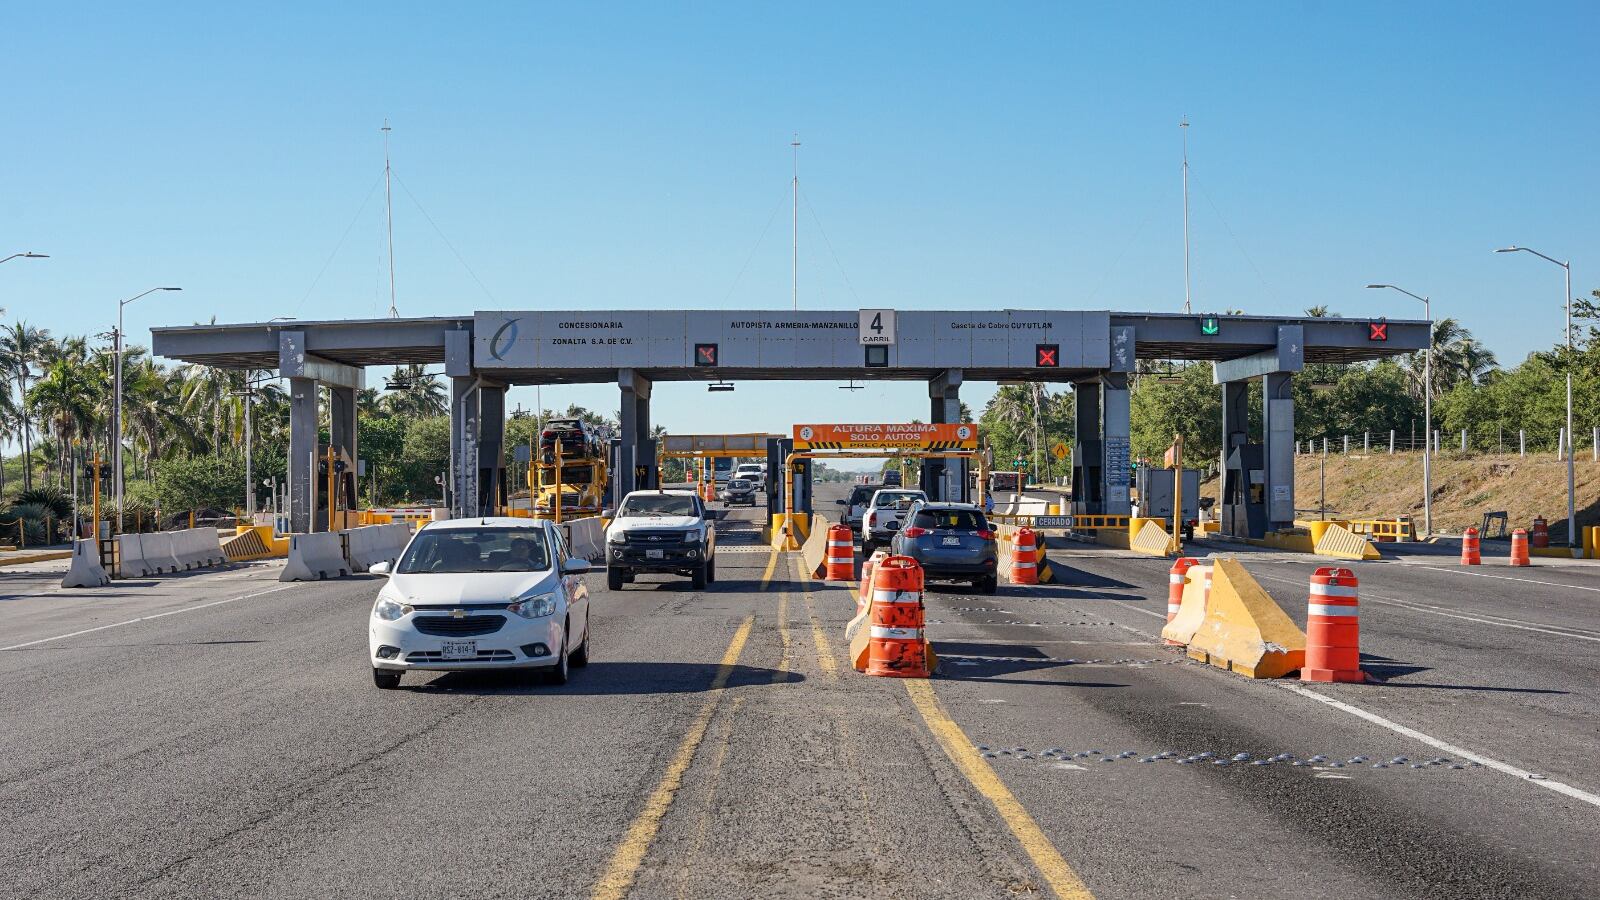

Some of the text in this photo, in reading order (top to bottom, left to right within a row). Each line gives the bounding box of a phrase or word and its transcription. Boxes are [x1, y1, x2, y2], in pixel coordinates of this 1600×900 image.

[730, 321, 772, 329] AUTOPISTA
[870, 311, 884, 335] 4
[1039, 518, 1070, 526] CERRADO
